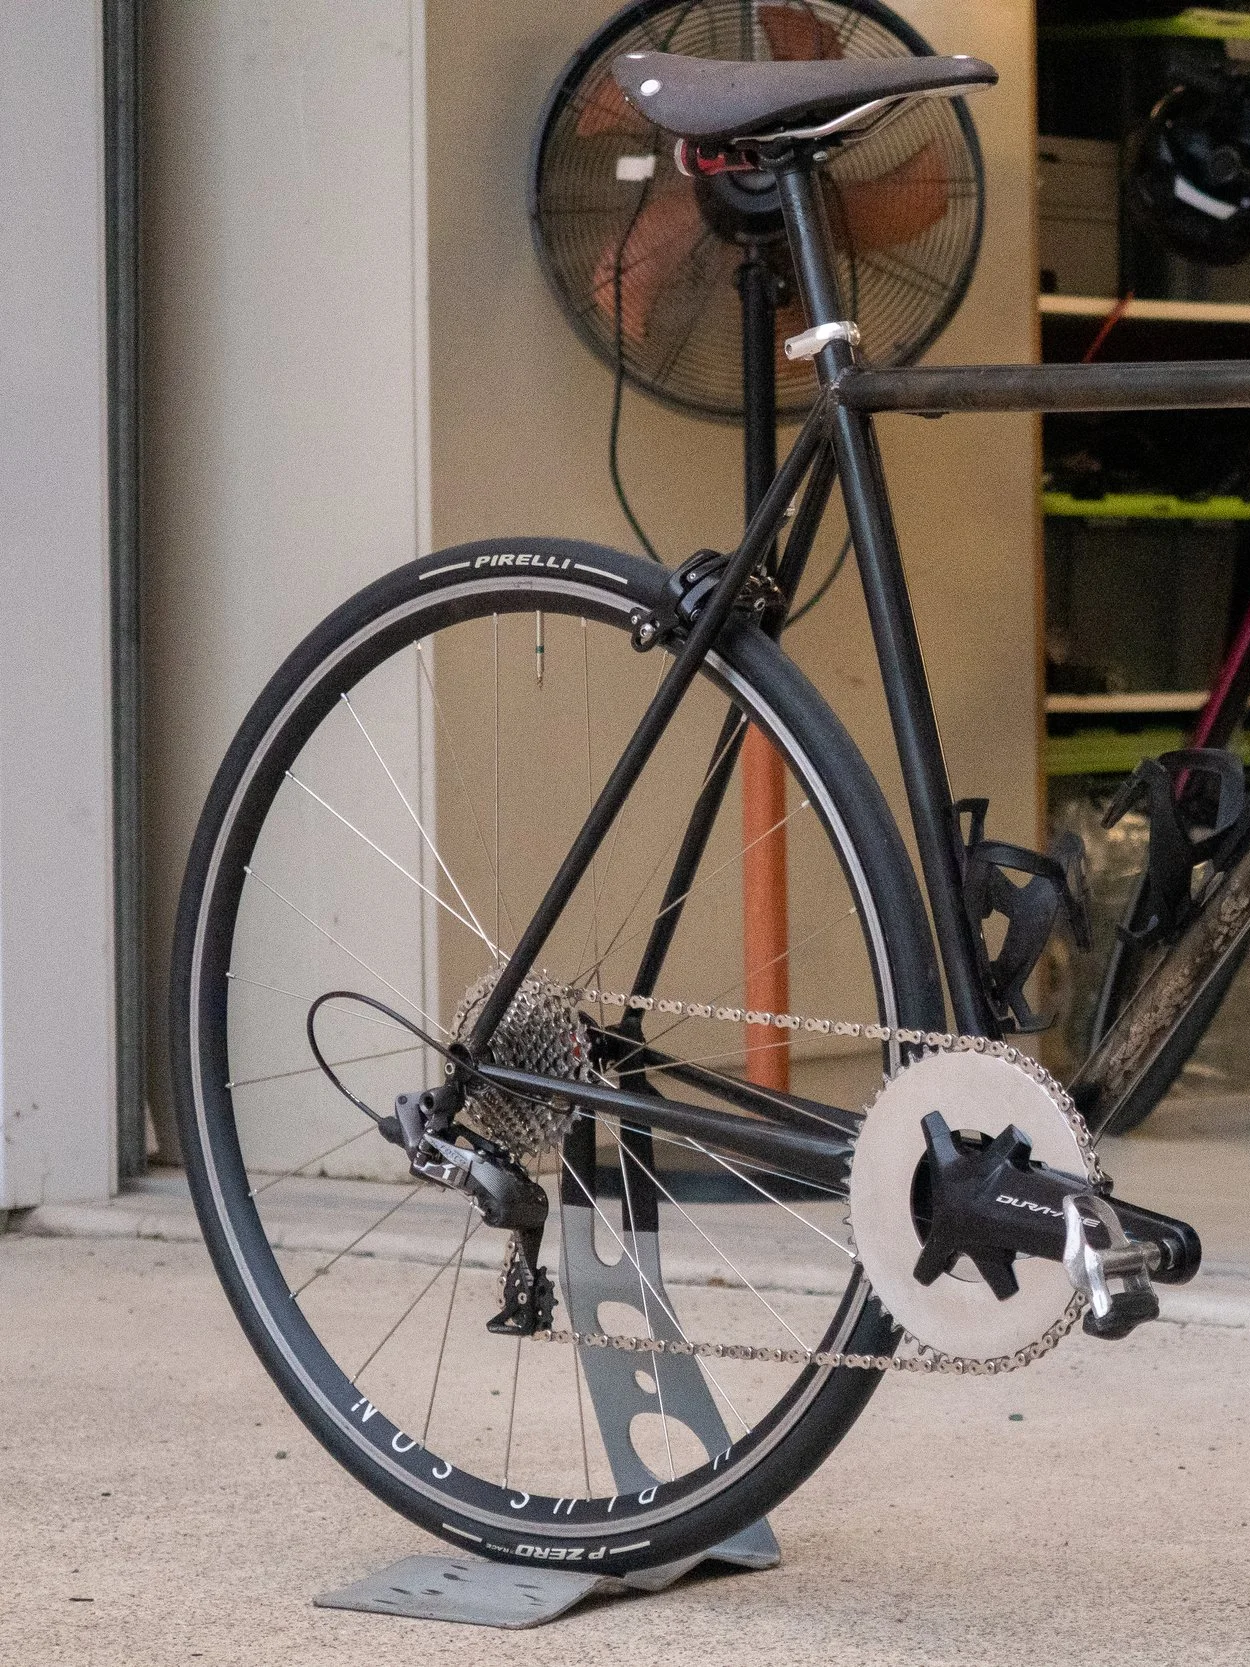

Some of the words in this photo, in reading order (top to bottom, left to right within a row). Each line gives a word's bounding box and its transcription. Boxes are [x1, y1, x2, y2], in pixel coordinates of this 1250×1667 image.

[474, 554, 571, 569] PIRELLI
[996, 1194, 1100, 1228] DURA-E
[514, 1544, 585, 1561] ZERO
[588, 1546, 607, 1560] P
